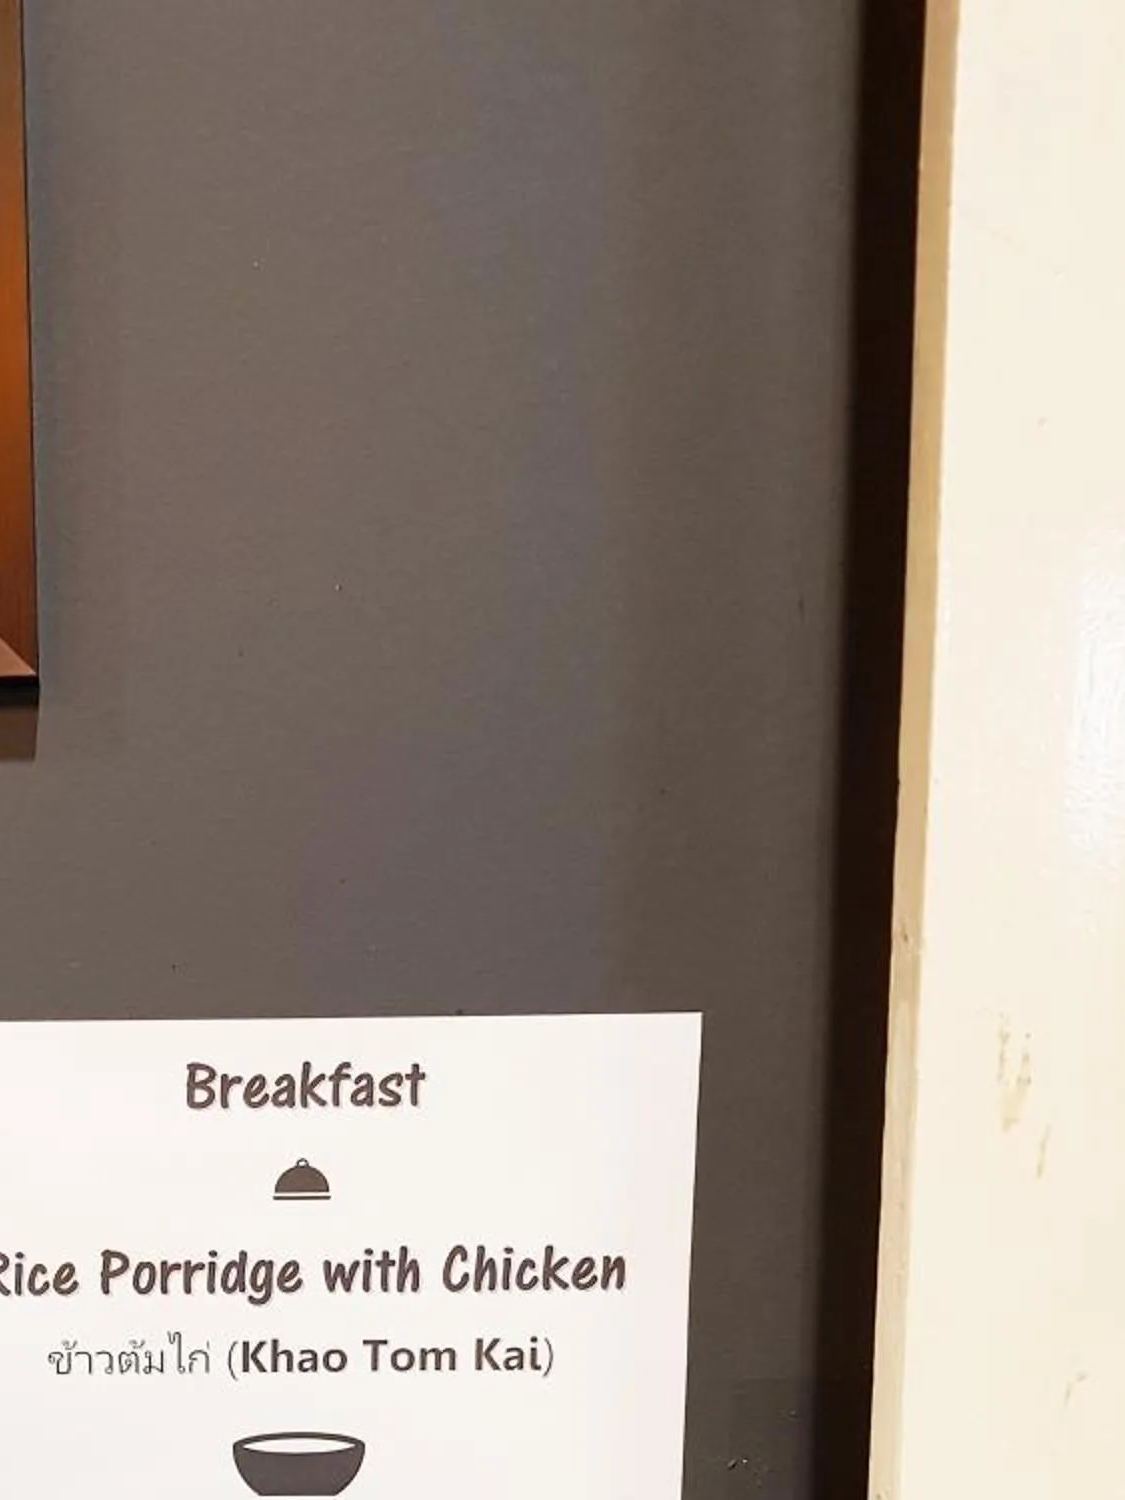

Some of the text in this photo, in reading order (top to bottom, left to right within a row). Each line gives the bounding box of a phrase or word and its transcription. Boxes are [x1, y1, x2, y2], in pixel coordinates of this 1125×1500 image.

[186, 1061, 426, 1109] Breakfast
[100, 1249, 304, 1305] Porridge
[323, 1246, 420, 1292] with
[442, 1245, 626, 1292] Chicken
[47, 1331, 555, 1381] ข้าวต้มไก่ (Khao Tom Kai)
